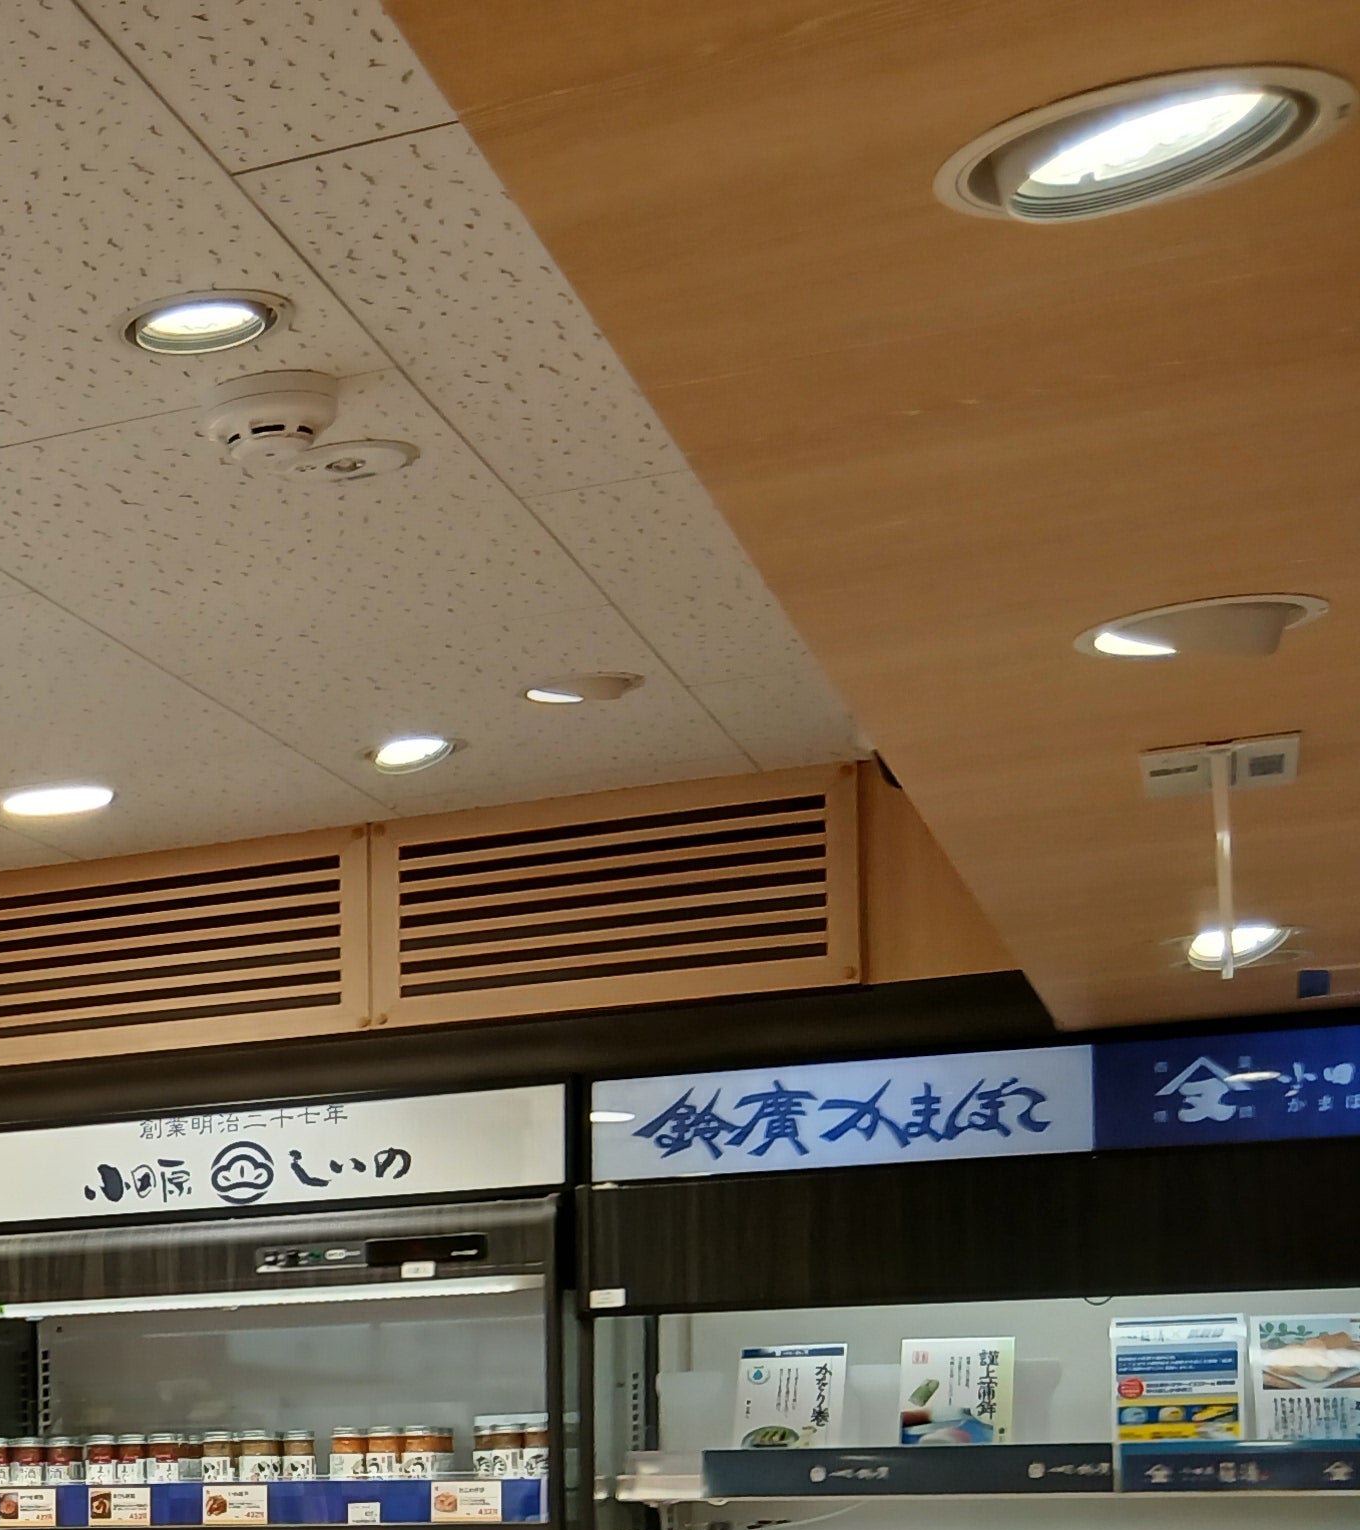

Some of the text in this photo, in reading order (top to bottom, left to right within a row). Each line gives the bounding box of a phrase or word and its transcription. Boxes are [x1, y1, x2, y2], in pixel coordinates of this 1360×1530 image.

[139, 1104, 348, 1141] 創業明治二十七年
[289, 1147, 412, 1188] しいの
